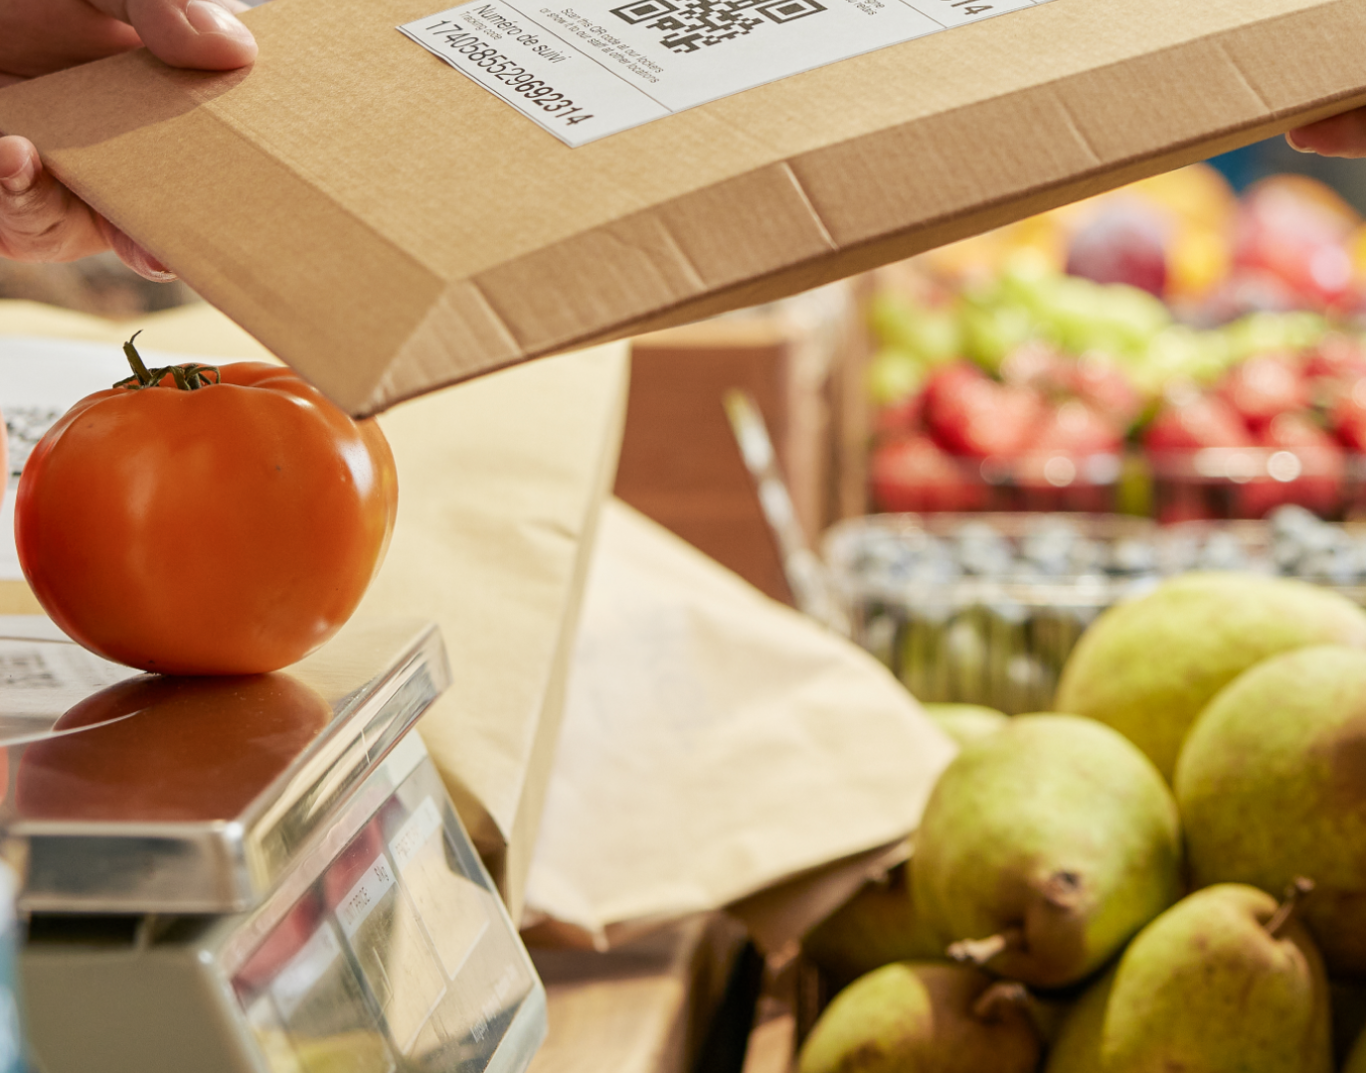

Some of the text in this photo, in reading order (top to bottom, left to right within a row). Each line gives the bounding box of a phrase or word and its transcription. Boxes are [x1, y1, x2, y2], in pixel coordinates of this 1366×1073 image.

[426, 20, 594, 126] 1740585529692314
[473, 4, 571, 64] Numéro de suivi
